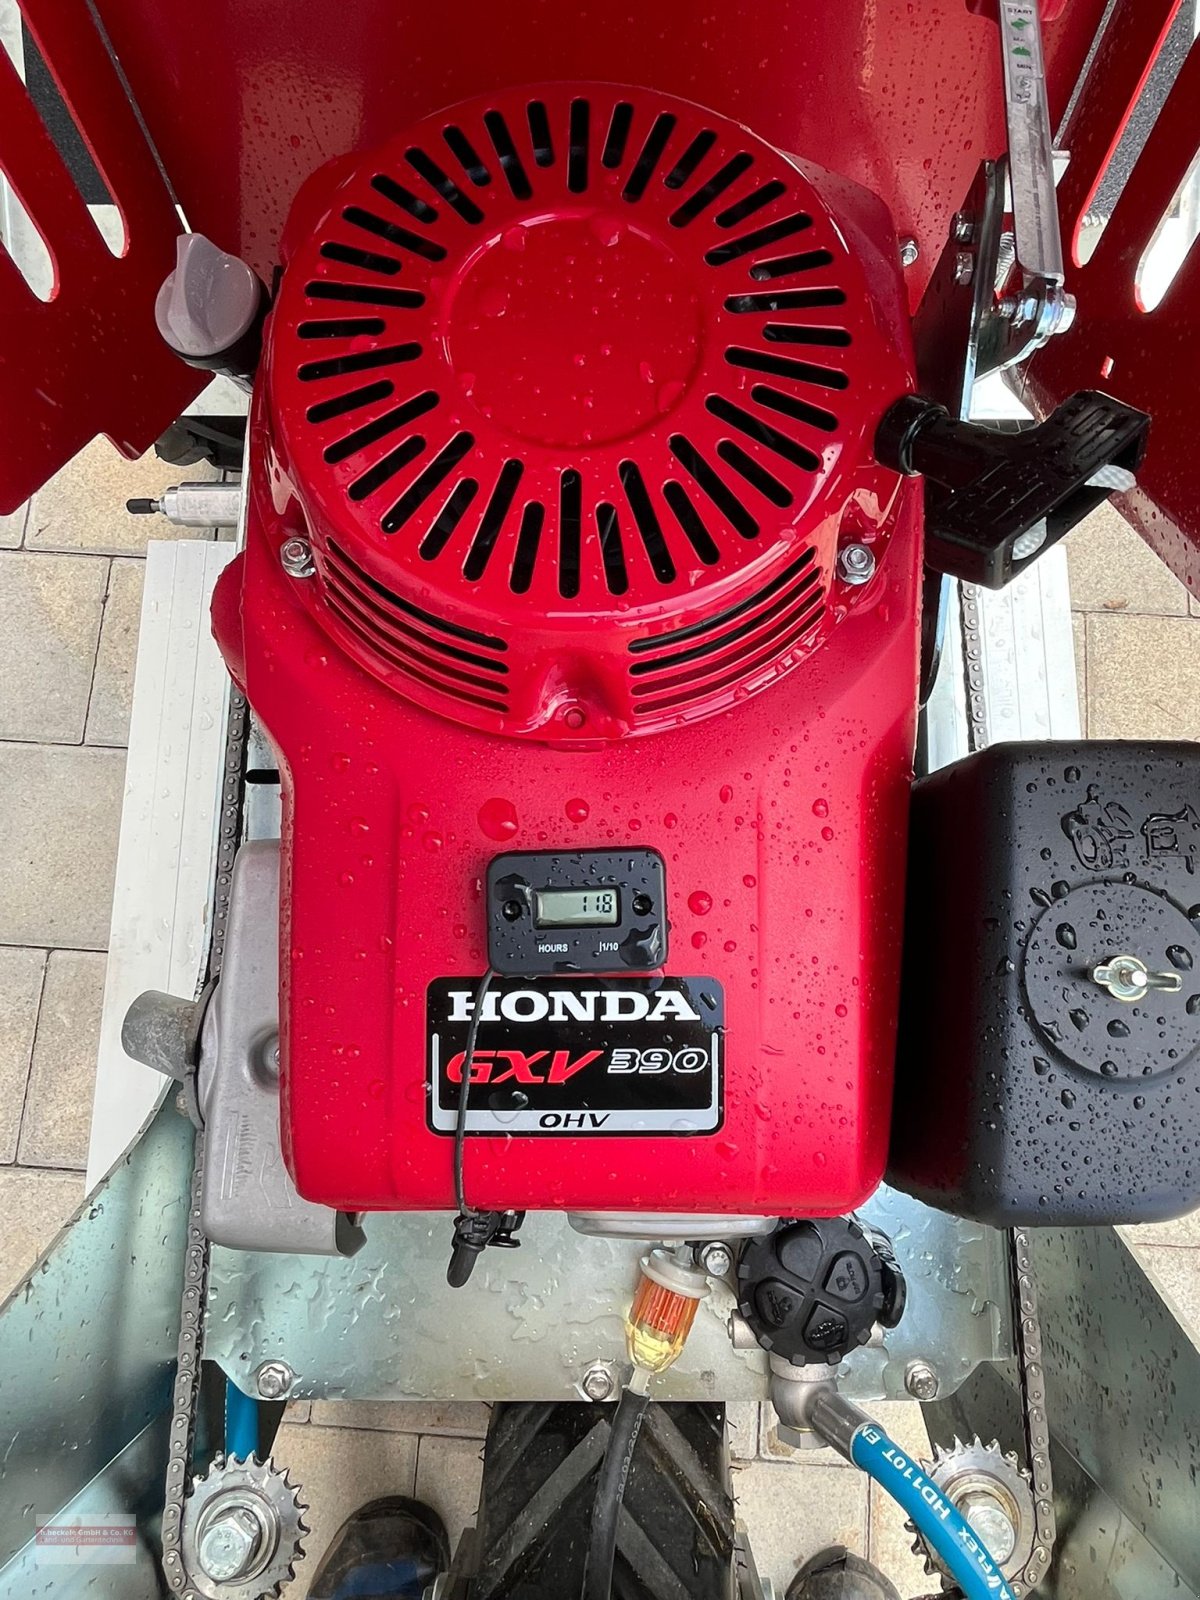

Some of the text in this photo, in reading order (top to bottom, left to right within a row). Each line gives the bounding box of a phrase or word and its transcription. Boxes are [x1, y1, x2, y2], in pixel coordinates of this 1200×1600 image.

[1007, 7, 1033, 15] START
[538, 943, 569, 953] HOURS
[447, 990, 701, 1022] HONDA
[446, 1047, 709, 1084] GXV 390
[539, 1113, 611, 1128] OHV
[881, 1448, 950, 1520] HD110T
